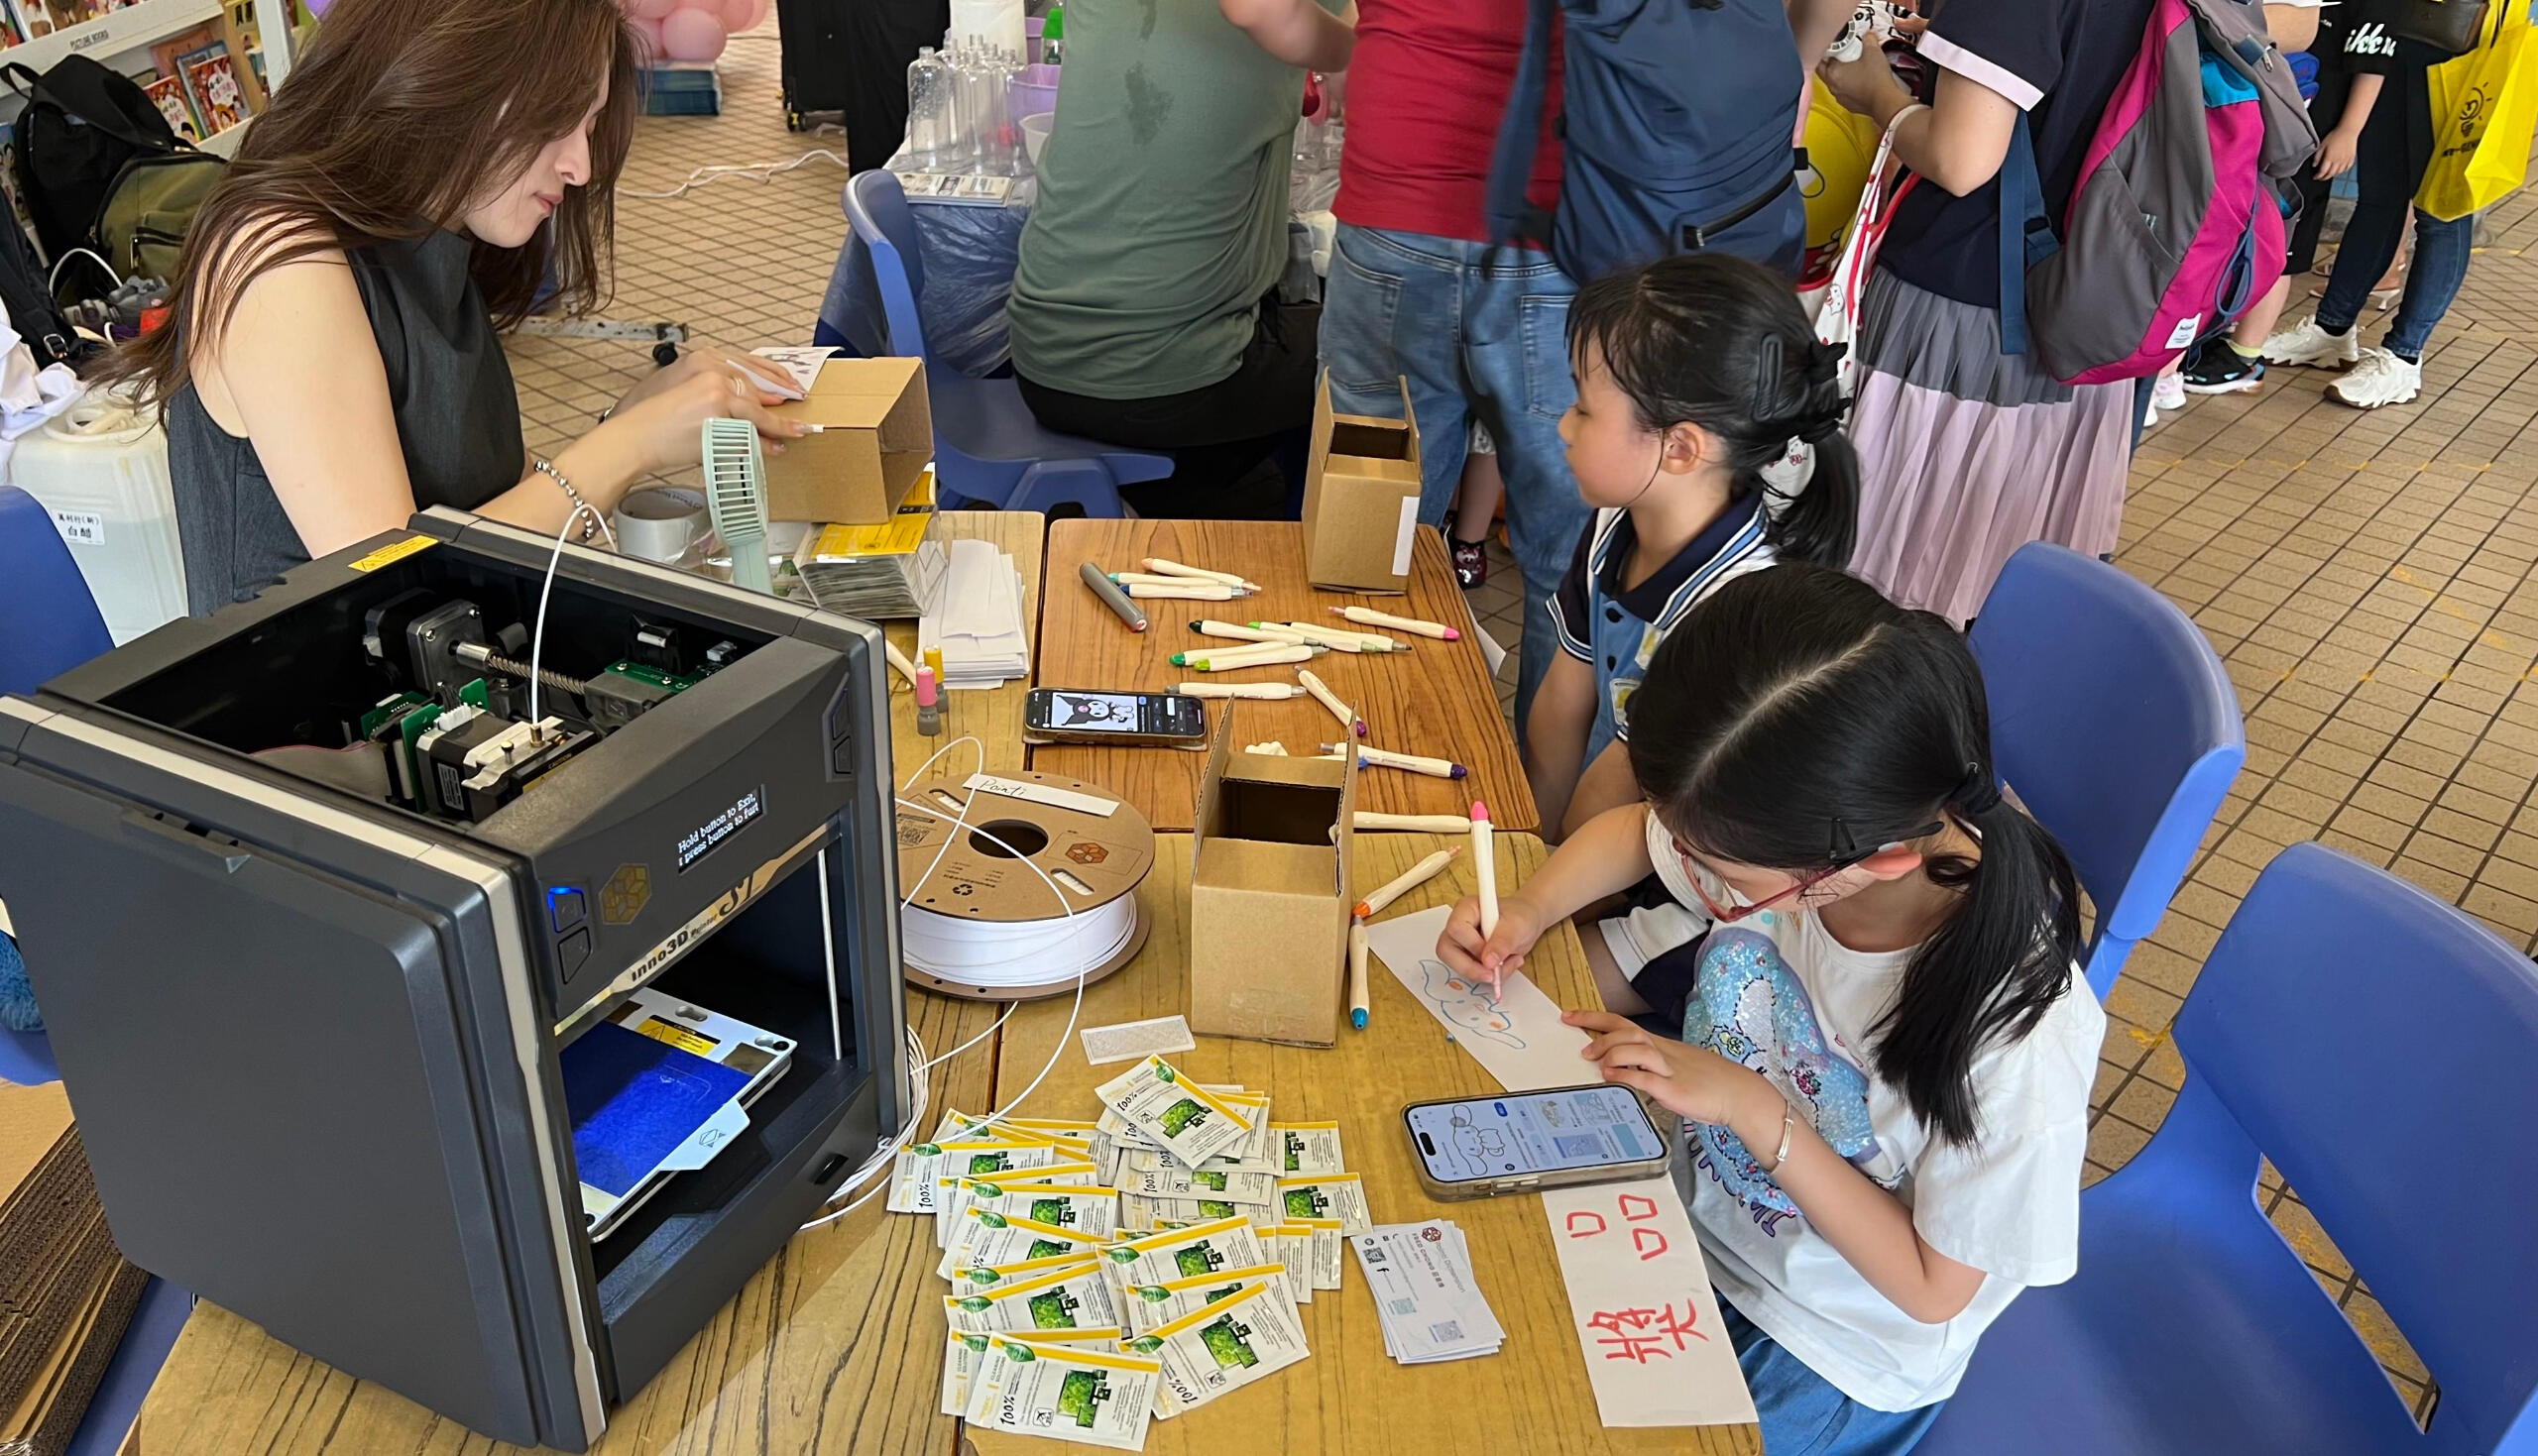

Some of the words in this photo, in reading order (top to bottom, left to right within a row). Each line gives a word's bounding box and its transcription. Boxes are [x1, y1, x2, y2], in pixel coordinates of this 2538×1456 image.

[678, 831, 699, 853] Hold
[700, 815, 727, 838] button
[727, 807, 737, 819] to
[684, 840, 707, 864] press
[707, 822, 734, 845] button
[735, 816, 744, 826] to
[632, 930, 688, 982] inno3D
[1117, 1092, 1137, 1111] 100%
[1124, 1121, 1137, 1136] 100
[918, 1183, 933, 1207] 100%
[1168, 1378, 1198, 1404] 100%
[1000, 1395, 1015, 1424] 100%
